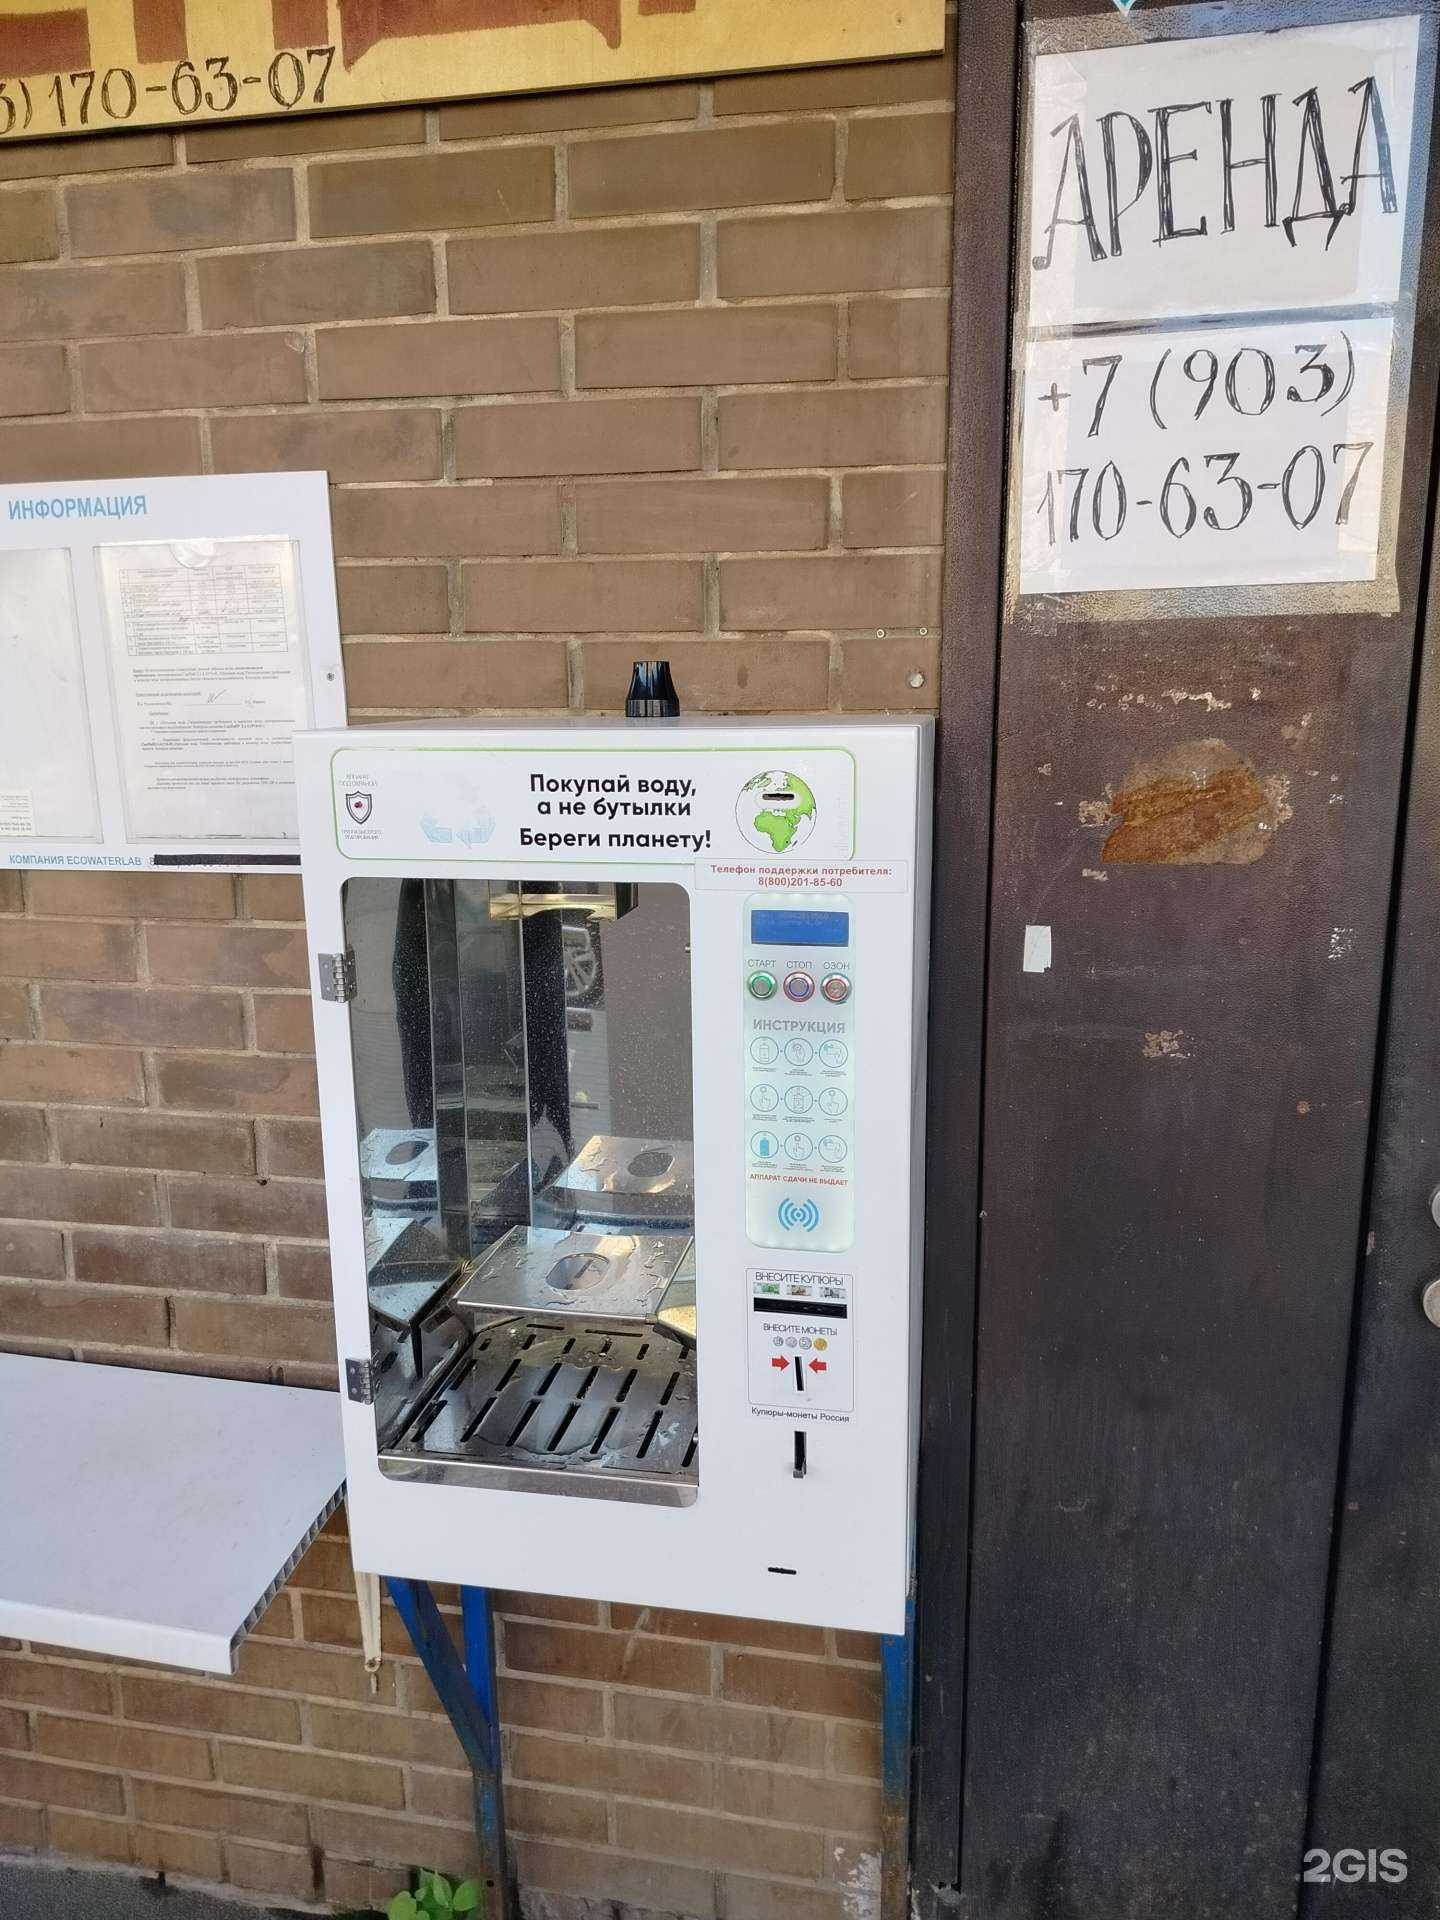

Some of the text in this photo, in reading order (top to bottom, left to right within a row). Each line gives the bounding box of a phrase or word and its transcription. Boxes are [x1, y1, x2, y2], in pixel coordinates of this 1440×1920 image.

[48, 46, 336, 128] 170-63-07
[1032, 76, 1398, 271] АРЕНДА
[1038, 330, 1355, 437] +7 (903)
[1038, 441, 1374, 546] 170-63-07
[8, 495, 148, 520] ИНФОРМАЦИЯ
[530, 773, 697, 797] Покупай воду,
[537, 797, 692, 820] а не бутылки
[519, 828, 711, 852] Береги планету!
[9, 854, 64, 866] КОМПАНИЯ
[66, 854, 142, 867] ECOWATERLAB
[711, 864, 893, 877] Телефон поддержки потребителя:
[758, 877, 843, 887] 8(800)201-85-60
[747, 959, 851, 970] СТАРТ СТОП ОЗОН
[753, 1018, 846, 1034] ИНСТРУКЦИЯ
[750, 1173, 781, 1182] АППАРАТ
[819, 1178, 849, 1186] ВЫДАЕТ
[755, 1271, 844, 1286] ВНЕСИТЕ КУПЮРЫ
[763, 1323, 838, 1336] ВНЕСИТЕ МОНЕТЫ
[751, 1407, 850, 1423] Купюры-монеты Россия
